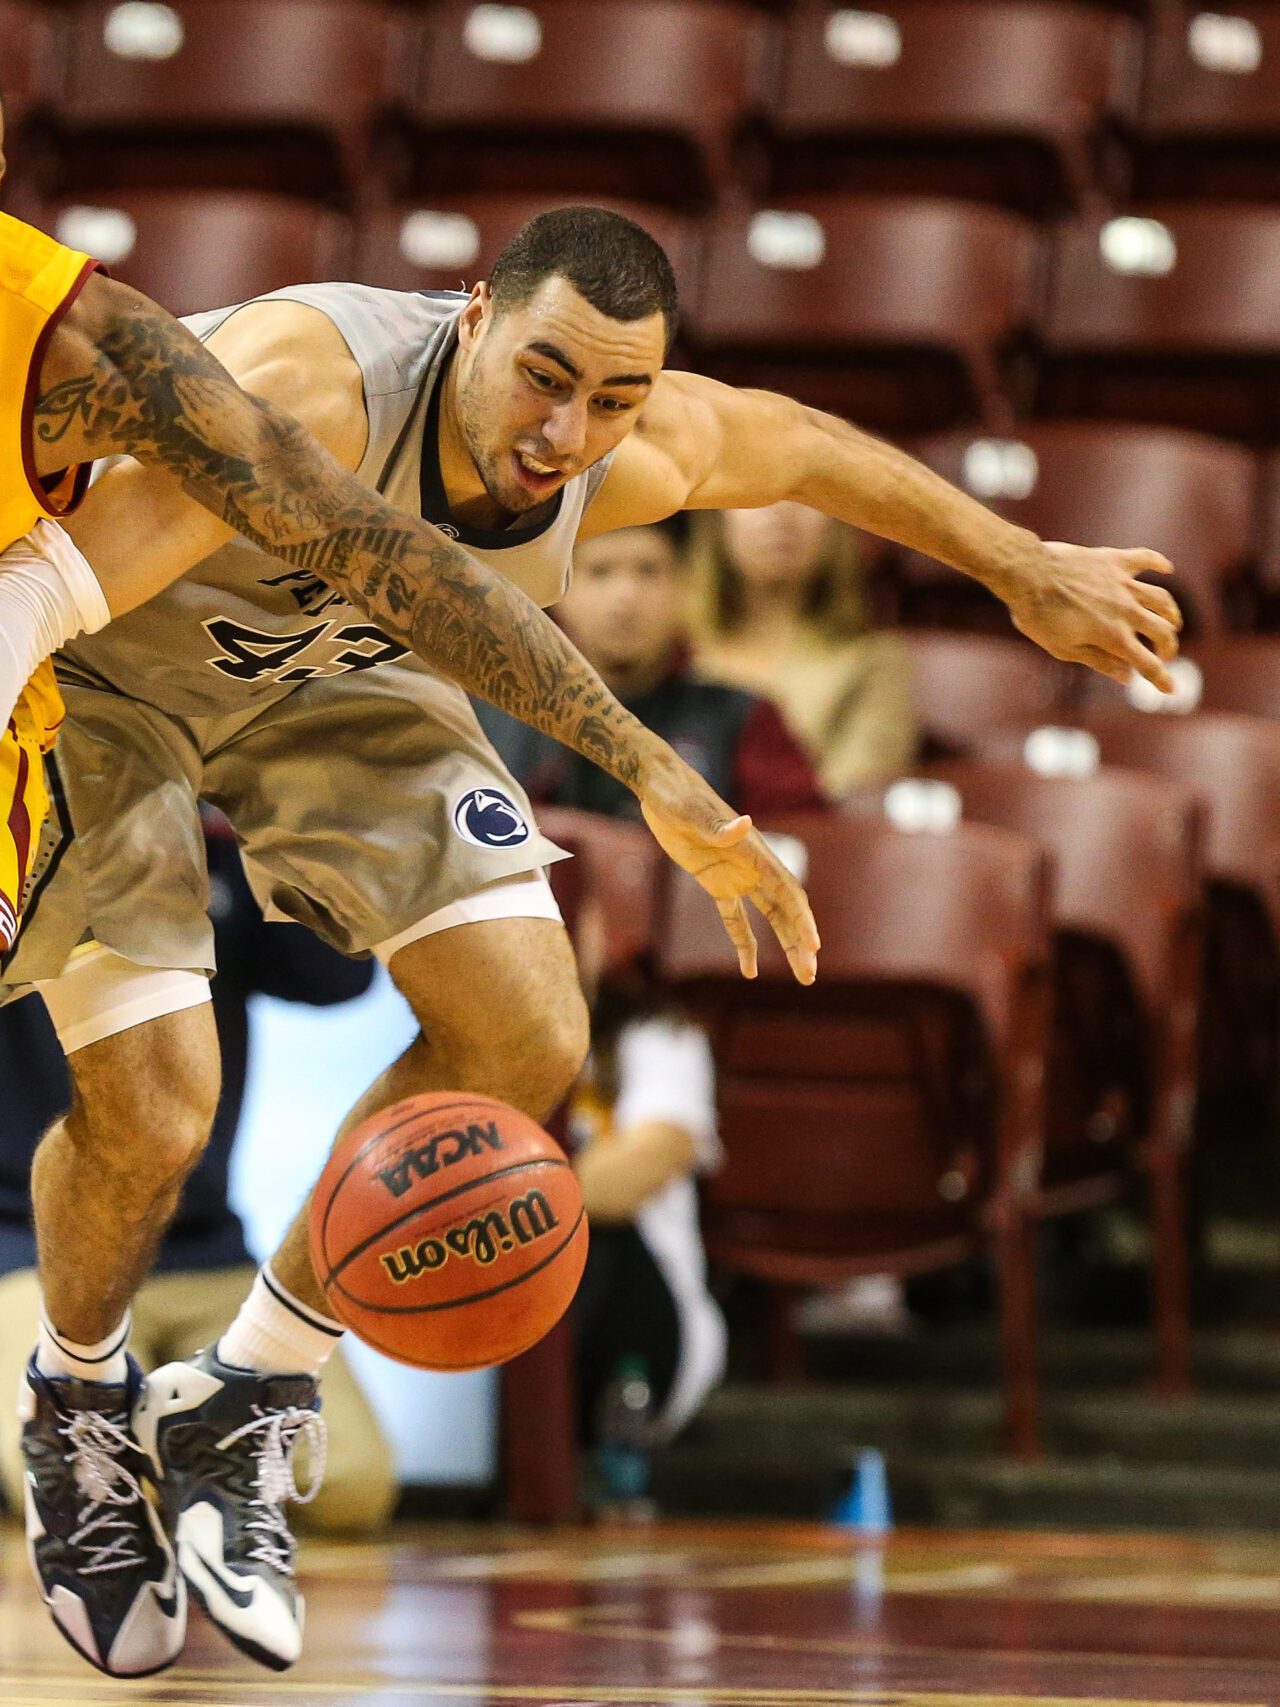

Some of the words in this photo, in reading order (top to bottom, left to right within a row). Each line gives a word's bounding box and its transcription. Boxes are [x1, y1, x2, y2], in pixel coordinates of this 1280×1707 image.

[200, 615, 413, 683] 43
[379, 1121, 506, 1198] NCAA
[380, 1189, 560, 1284] Wilson
